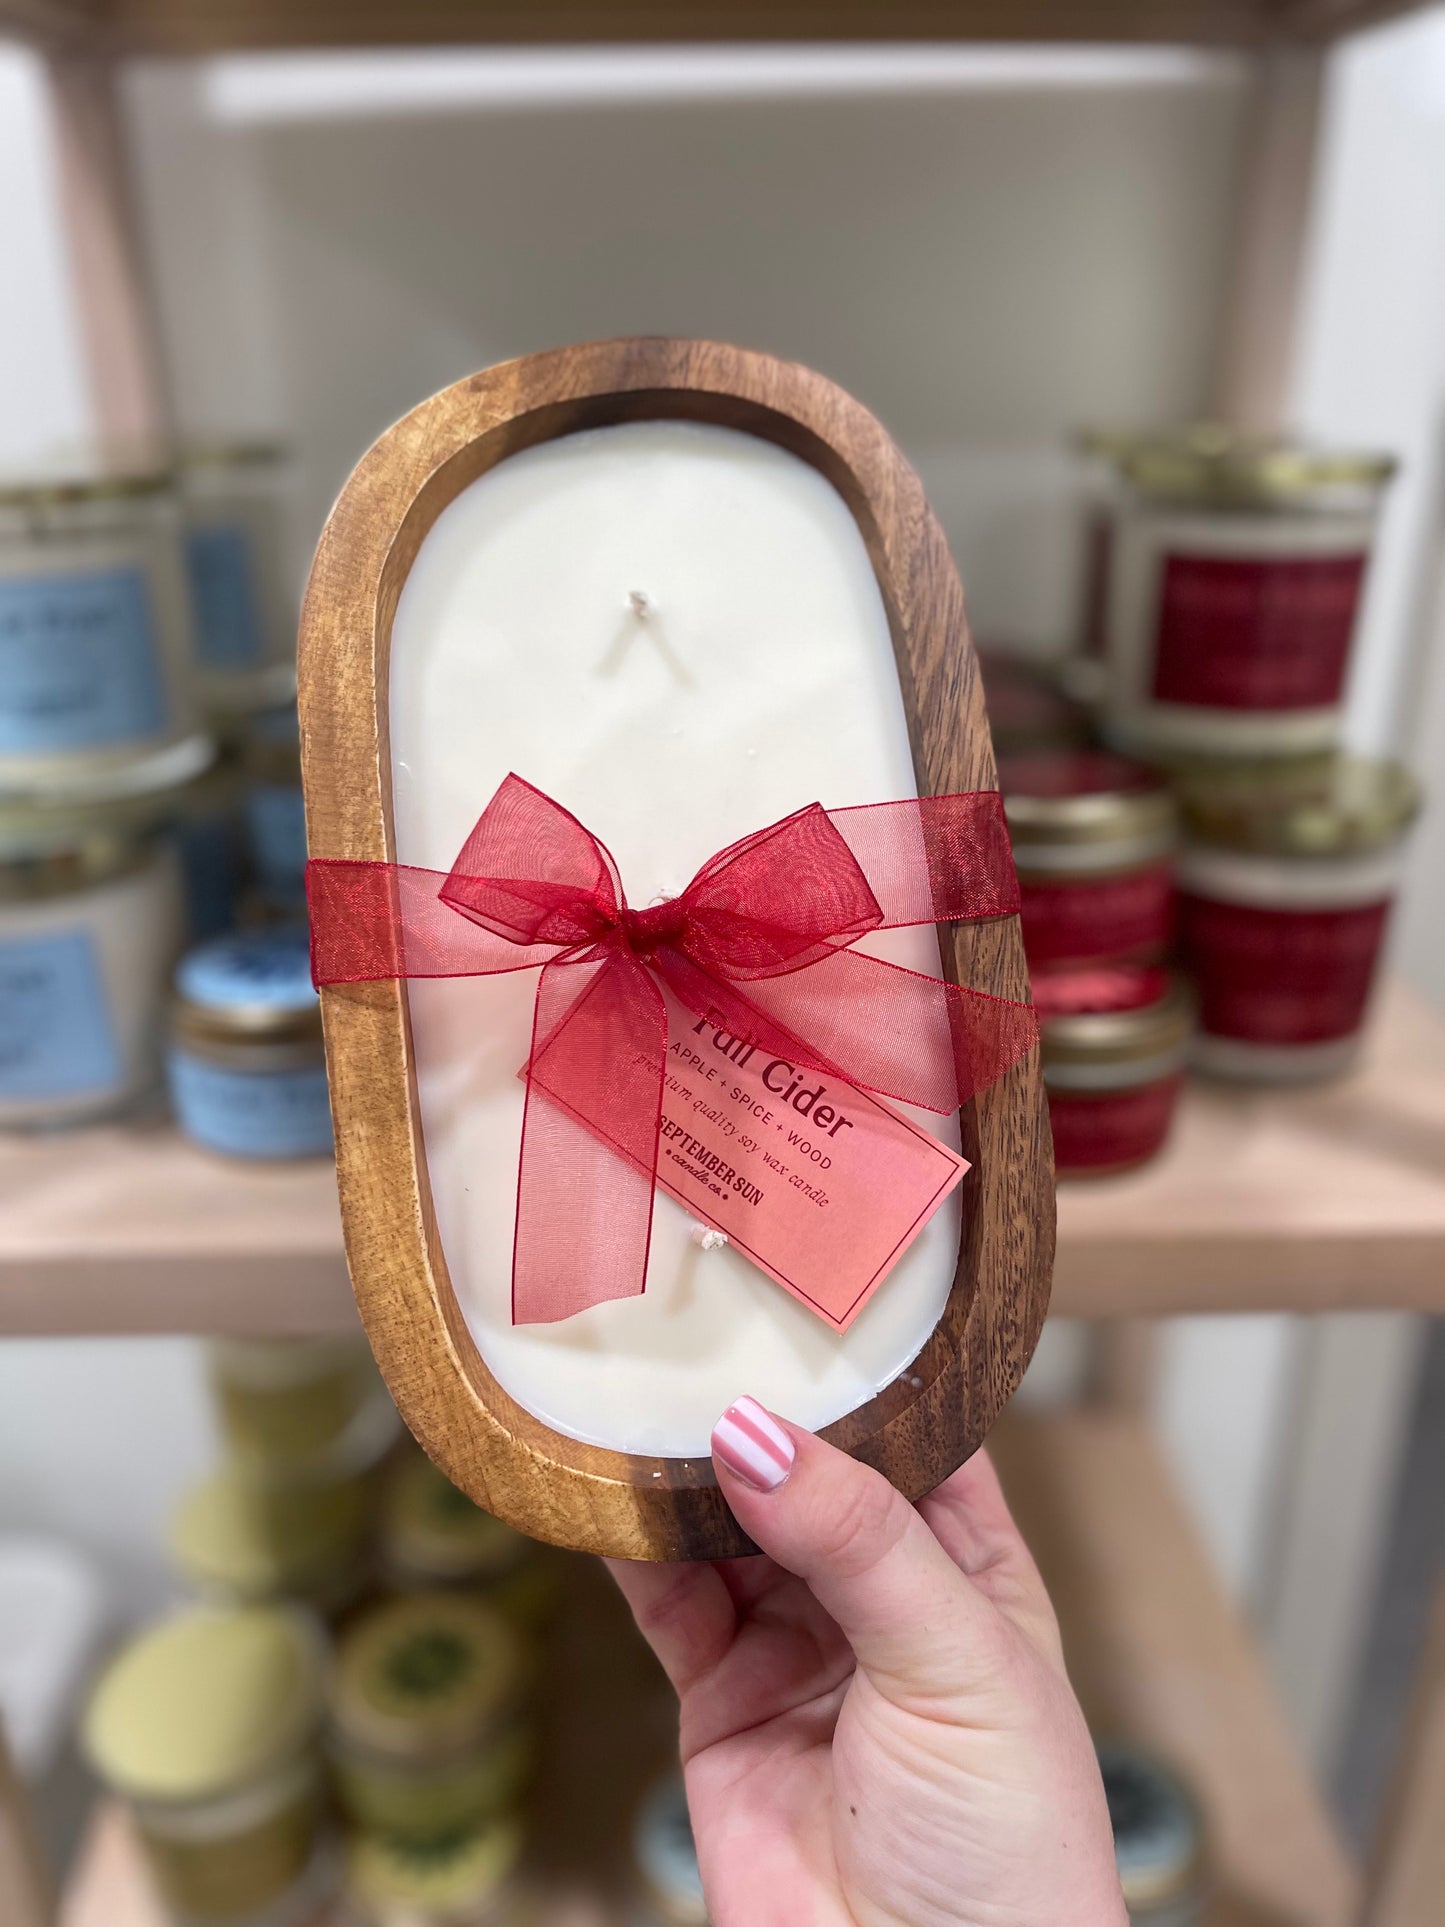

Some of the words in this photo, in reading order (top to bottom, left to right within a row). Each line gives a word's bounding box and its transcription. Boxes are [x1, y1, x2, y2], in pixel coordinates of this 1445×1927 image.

[670, 1042, 717, 1081] APPLE
[730, 1087, 774, 1125] SPICE
[787, 1130, 832, 1170] WOOD
[762, 1060, 853, 1138] Cider
[693, 1100, 739, 1136] quality
[738, 1135, 761, 1154] soy
[763, 1152, 789, 1175] wax
[788, 1174, 829, 1208] candle
